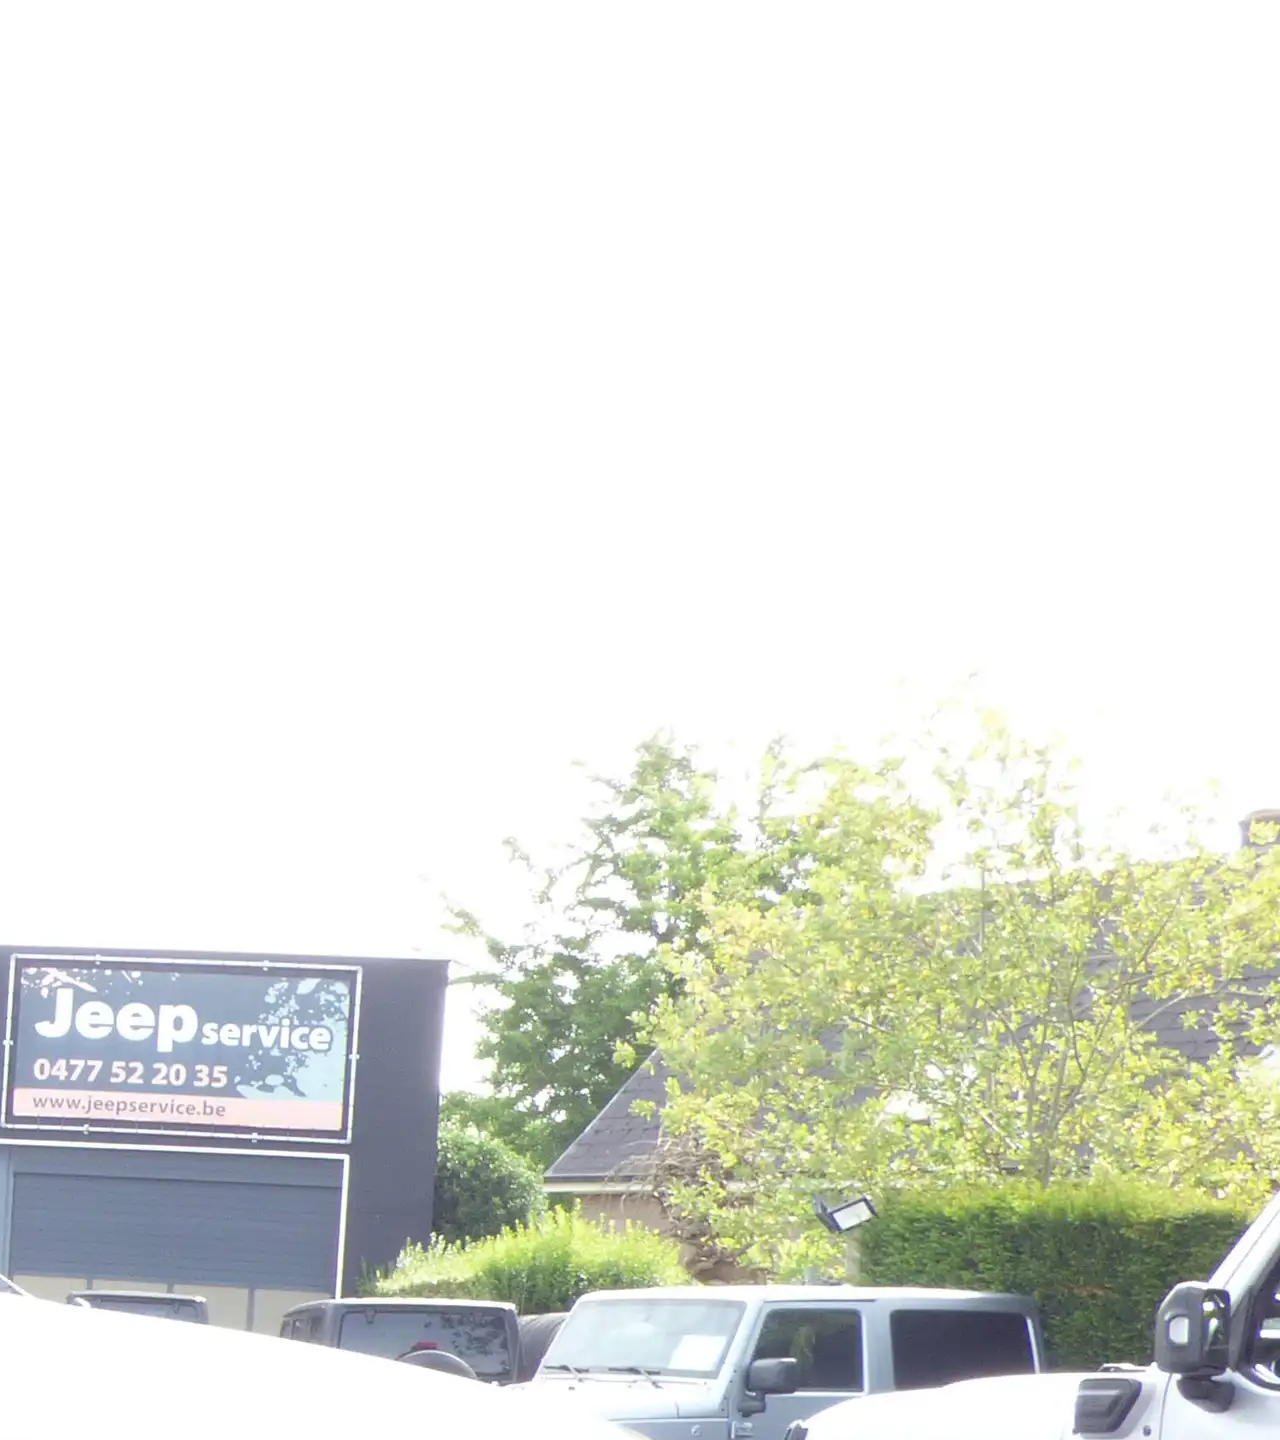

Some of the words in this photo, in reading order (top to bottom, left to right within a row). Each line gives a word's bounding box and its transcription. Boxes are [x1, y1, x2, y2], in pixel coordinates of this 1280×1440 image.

[34, 987, 198, 1052] Jeep
[200, 1018, 332, 1051] service
[33, 1058, 103, 1082] 0477
[109, 1060, 144, 1084] 52
[151, 1063, 187, 1086] 20
[193, 1065, 229, 1088] 35
[32, 1095, 227, 1118] www.jeepservice.be
